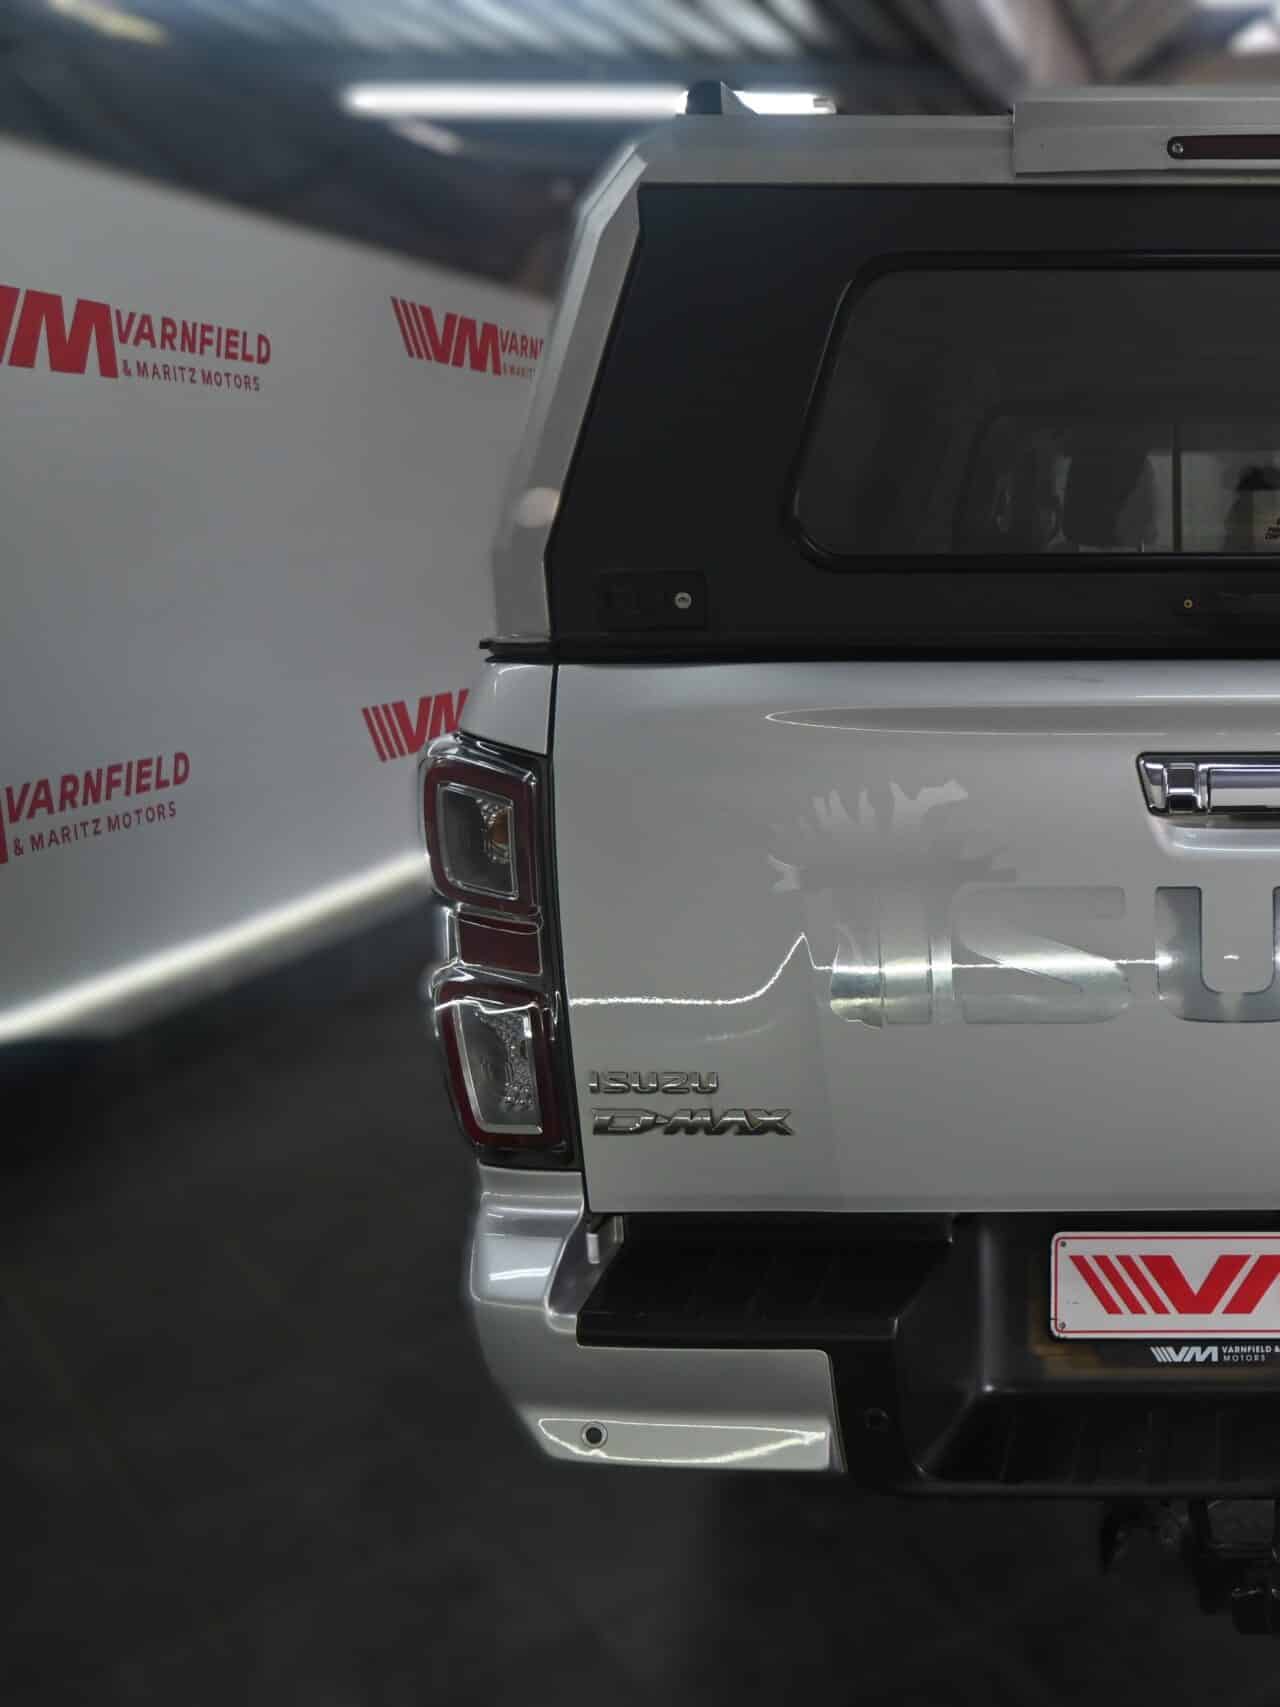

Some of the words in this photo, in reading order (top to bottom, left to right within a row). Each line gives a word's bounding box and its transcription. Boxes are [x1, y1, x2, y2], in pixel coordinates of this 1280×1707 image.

[115, 309, 272, 366] VARNFIELD
[419, 304, 501, 376] VM
[122, 359, 132, 377] &
[136, 360, 197, 385] MARITZ
[201, 369, 260, 392] MOTORS
[5, 752, 190, 825] VARNFIELD
[13, 833, 25, 856] &
[30, 818, 103, 852] MARITZ
[107, 801, 177, 832] MOTORS
[588, 1070, 718, 1094] ISUZU
[592, 1108, 794, 1136] D-MAX
[1164, 1346, 1218, 1362] VM
[1222, 1345, 1271, 1353] VARNFIELD
